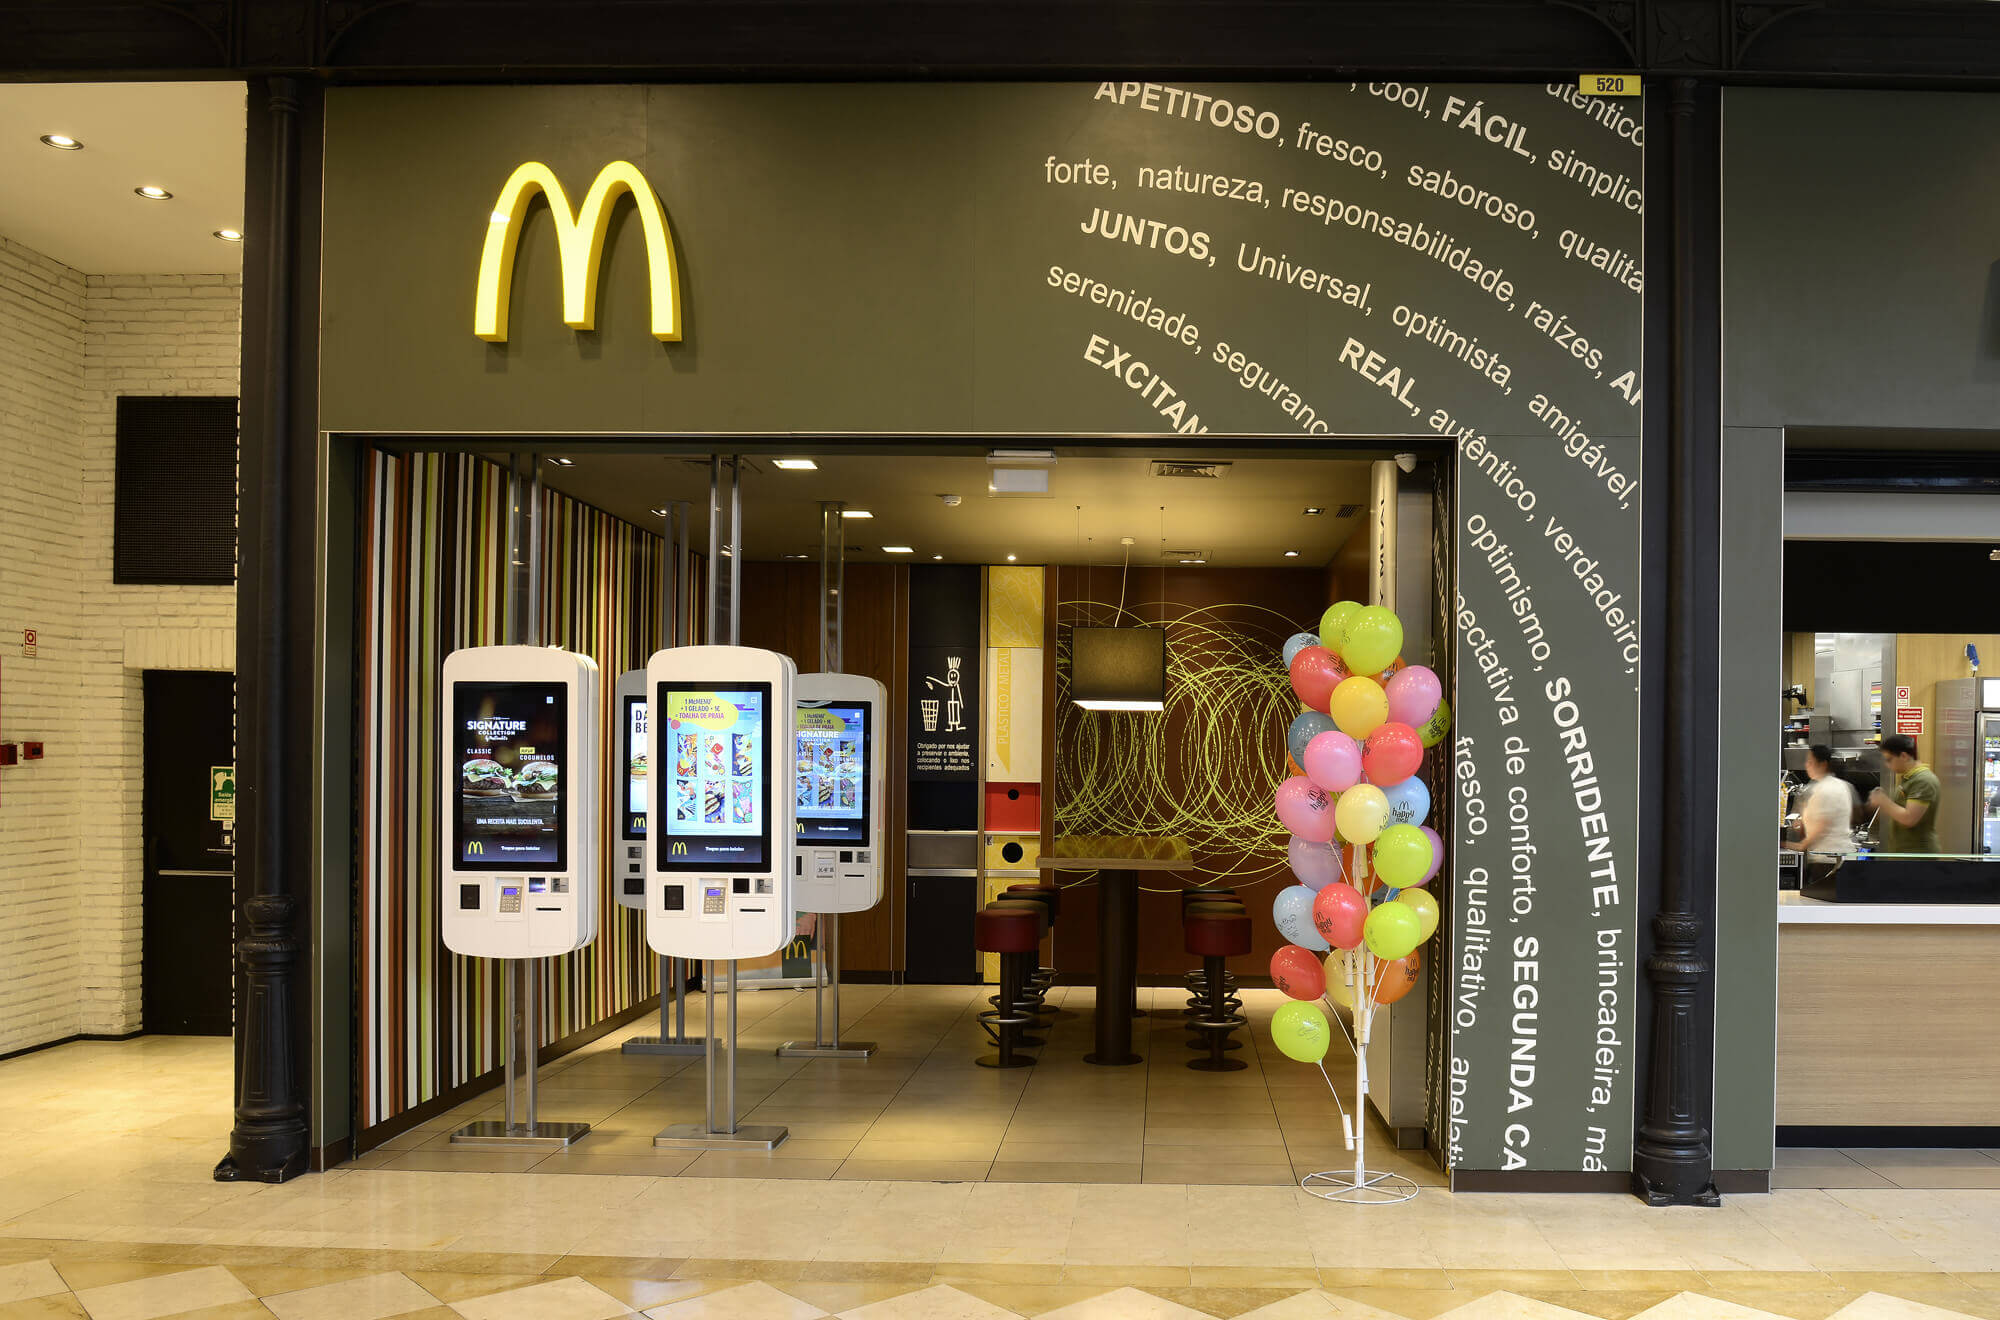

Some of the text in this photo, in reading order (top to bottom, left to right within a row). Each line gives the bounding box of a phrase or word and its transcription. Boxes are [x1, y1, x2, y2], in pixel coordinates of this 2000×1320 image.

[1368, 81, 1431, 119] cool,
[1441, 95, 1537, 166] FÁCIL,
[1597, 78, 1624, 92] 520
[1093, 81, 1643, 295] APETITOSO, fresco, saboroso, qualita
[1044, 155, 1117, 190] forte,
[1138, 165, 1270, 209] natureza,
[1281, 187, 1516, 312] responsabilidade,
[1523, 300, 1603, 380] raízes,
[1046, 263, 1202, 355] serenidade,
[1079, 207, 1638, 510] JUNTOS, Universal, optimista, amigável,
[1338, 336, 1639, 674] REAL, autêntico, verdadeiro,
[467, 720, 527, 731] SIGNATURE
[1455, 735, 1488, 845] fresco,
[1503, 736, 1531, 776] de
[1467, 514, 1551, 672] optimismo,
[1544, 676, 1620, 917] SORRIDENTE,
[1585, 928, 1624, 1113] brincadeira,
[1507, 786, 1537, 923] conforto,
[1454, 866, 1492, 1035] qualitativo,
[1507, 935, 1539, 1114] SEGUNDA
[1500, 1123, 1531, 1171] CA
